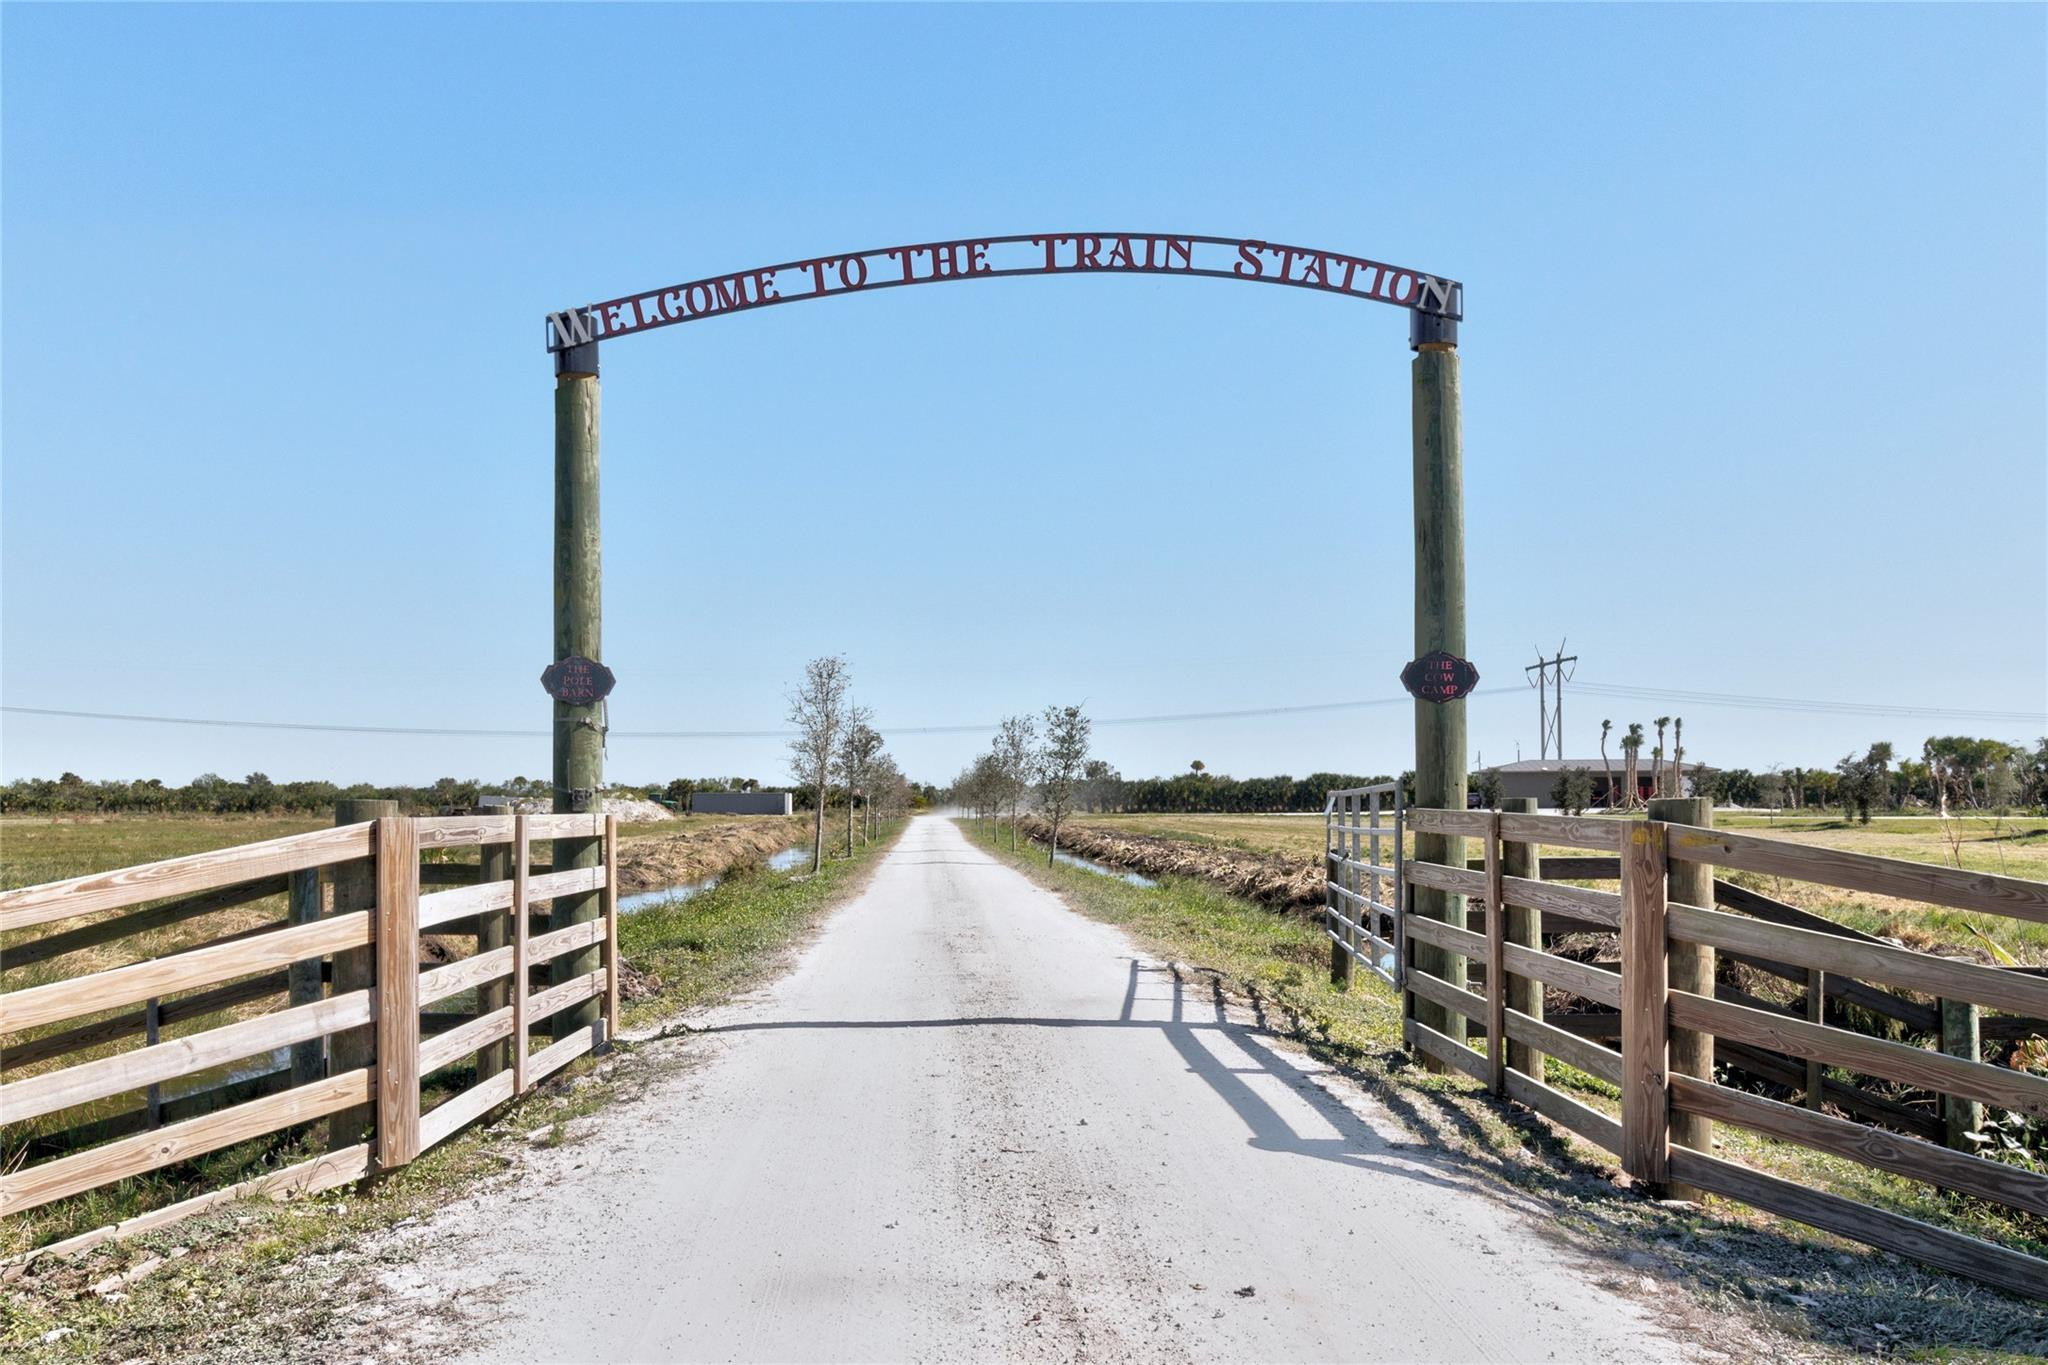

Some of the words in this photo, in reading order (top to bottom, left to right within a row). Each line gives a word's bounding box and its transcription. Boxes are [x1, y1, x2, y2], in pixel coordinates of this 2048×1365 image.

[547, 267, 781, 347] WELCOME
[800, 254, 868, 297] TO
[889, 239, 992, 284] THE
[1032, 233, 1195, 272] TRAIN
[1233, 239, 1457, 314] STATION
[567, 664, 591, 673] THE
[1430, 660, 1453, 670] THE
[562, 687, 594, 697] BARN
[1421, 685, 1458, 695] CAMP
